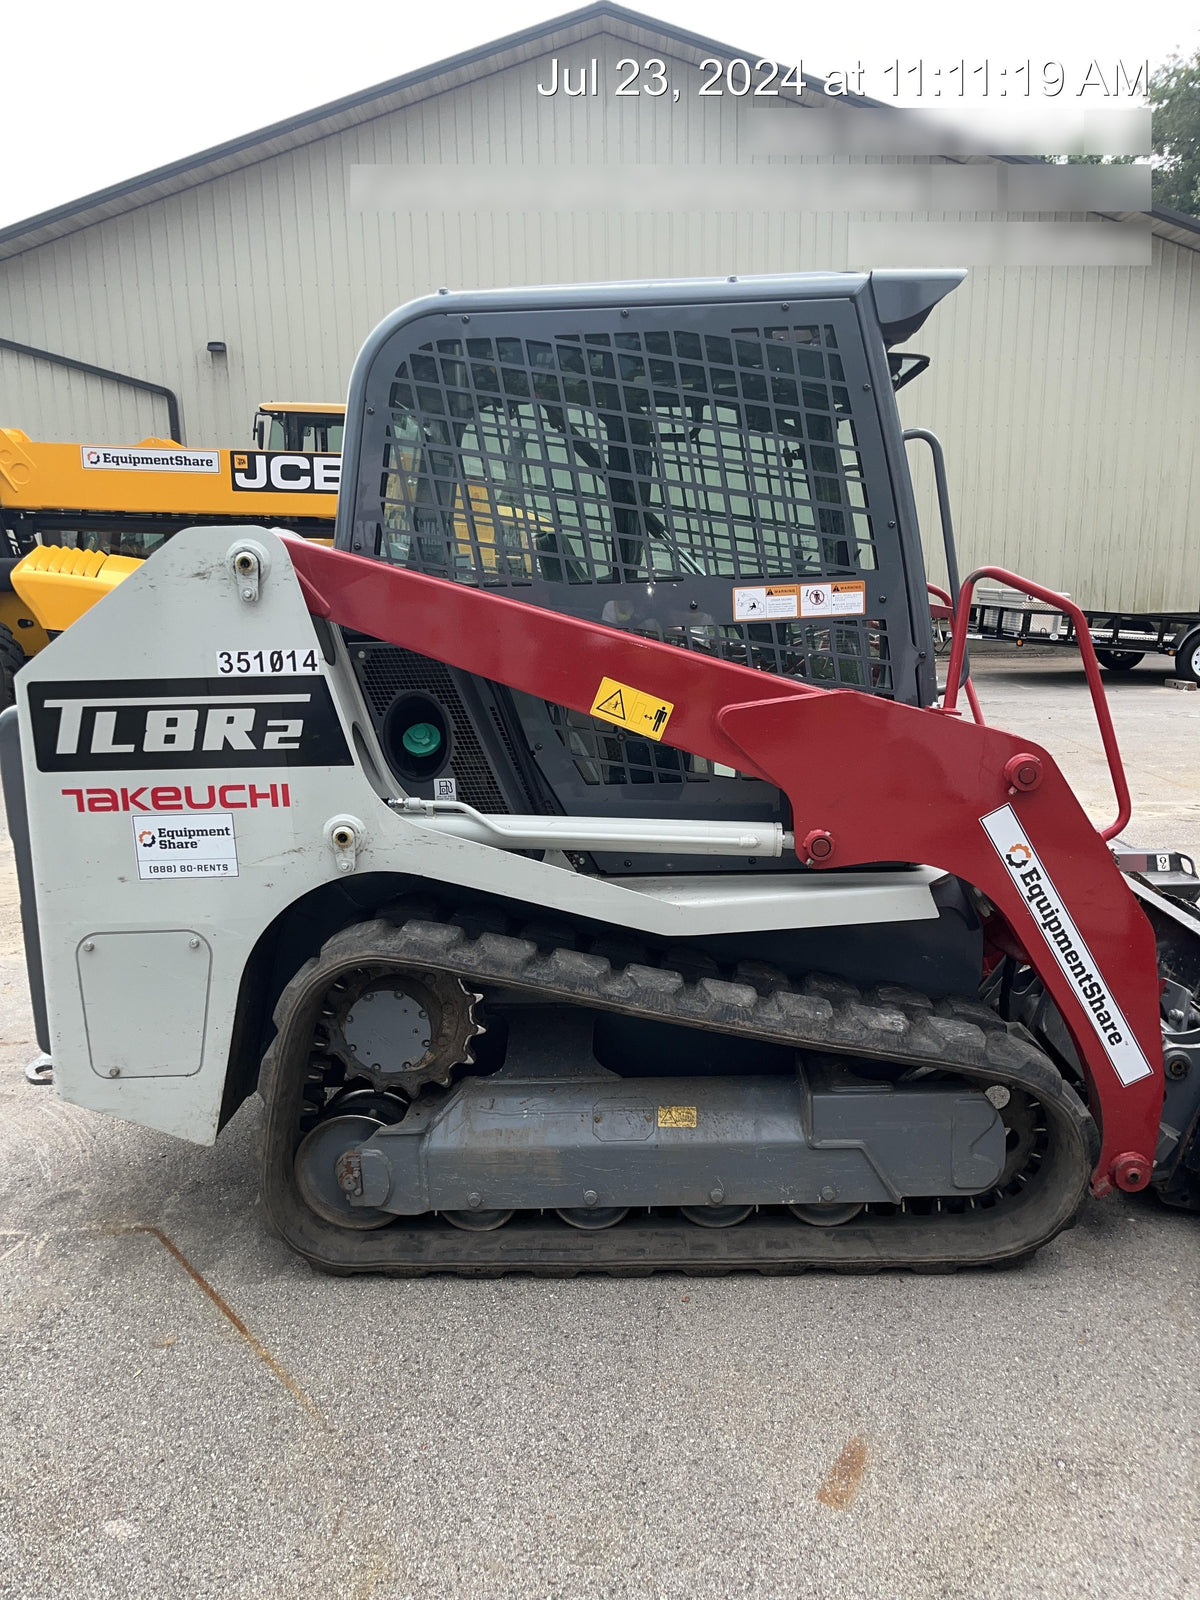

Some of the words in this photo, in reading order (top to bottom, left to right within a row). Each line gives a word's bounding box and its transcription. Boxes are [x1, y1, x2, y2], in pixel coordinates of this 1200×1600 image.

[103, 453, 213, 467] EquipmentShare
[218, 650, 318, 674] 351014
[44, 693, 311, 754] TL8R2
[158, 827, 230, 839] Equipment
[159, 839, 198, 849] Share
[149, 865, 177, 874] (888)
[180, 864, 228, 872] 80-RENTS
[1020, 867, 1123, 1046] EquipmentShare
